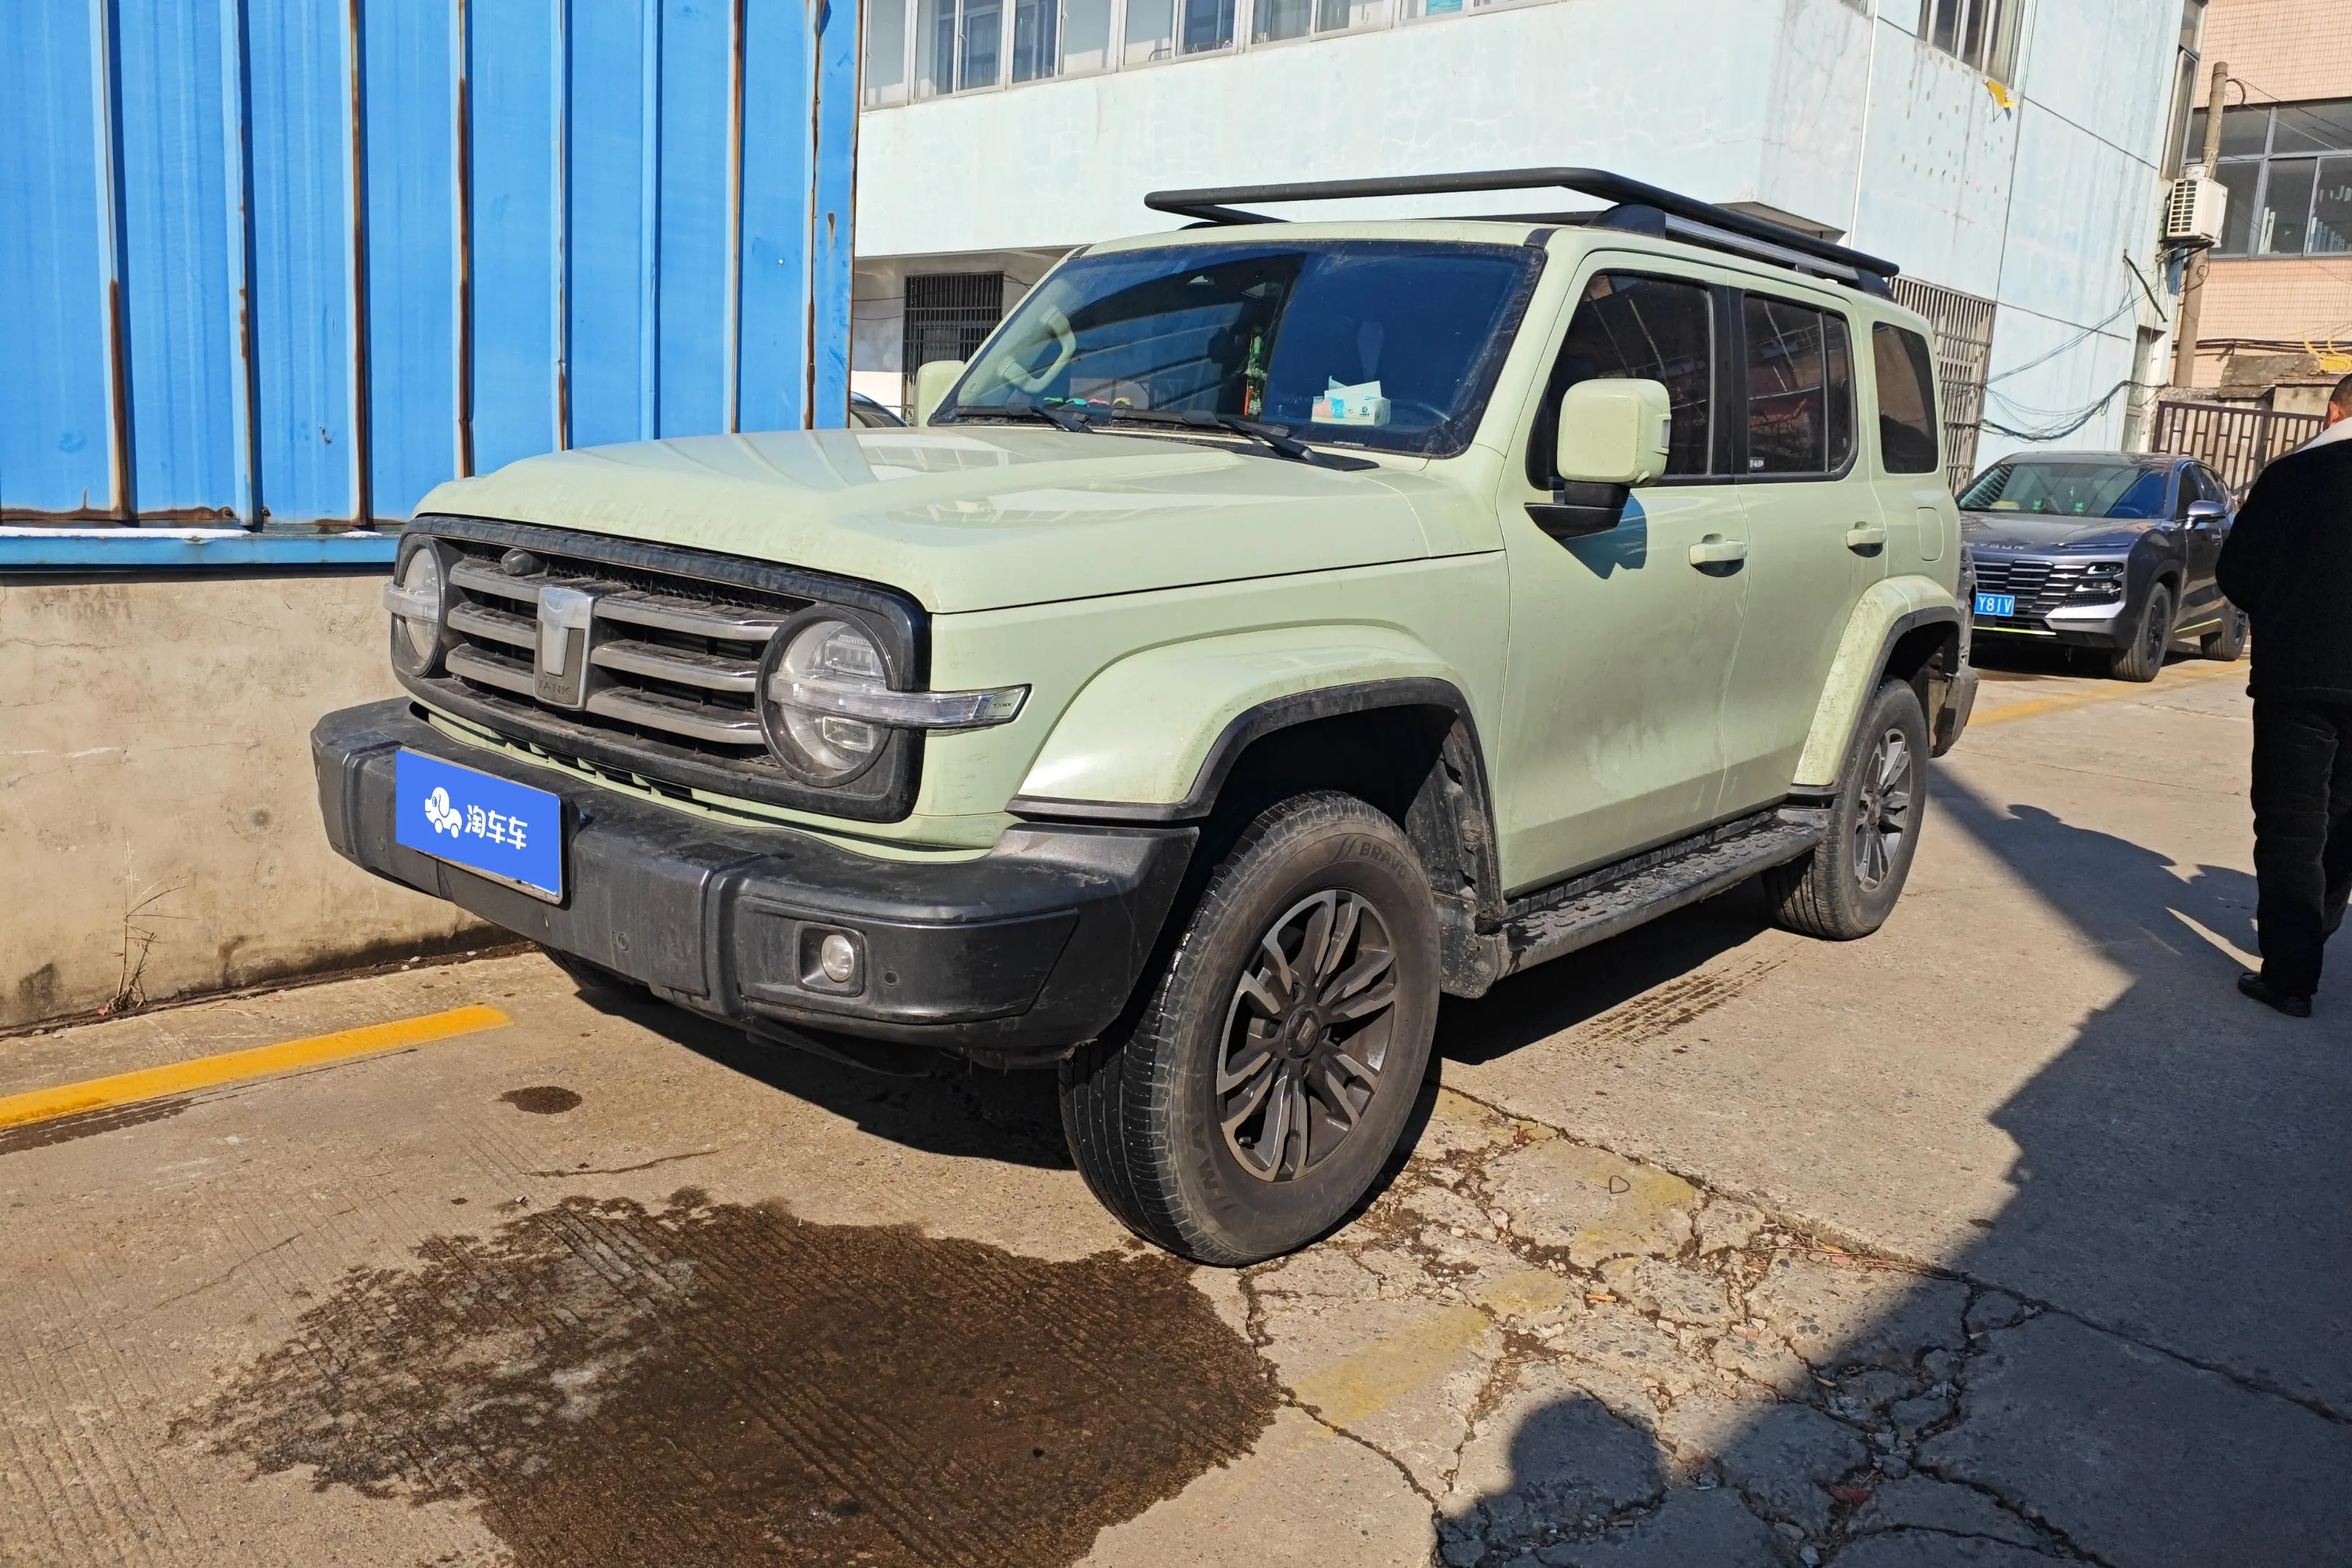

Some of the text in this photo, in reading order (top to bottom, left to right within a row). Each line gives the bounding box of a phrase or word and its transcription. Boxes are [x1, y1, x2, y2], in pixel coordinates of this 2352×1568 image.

[1979, 596, 2013, 613] Y81V
[539, 680, 571, 697] TANK
[1358, 842, 1407, 879] BRAVO
